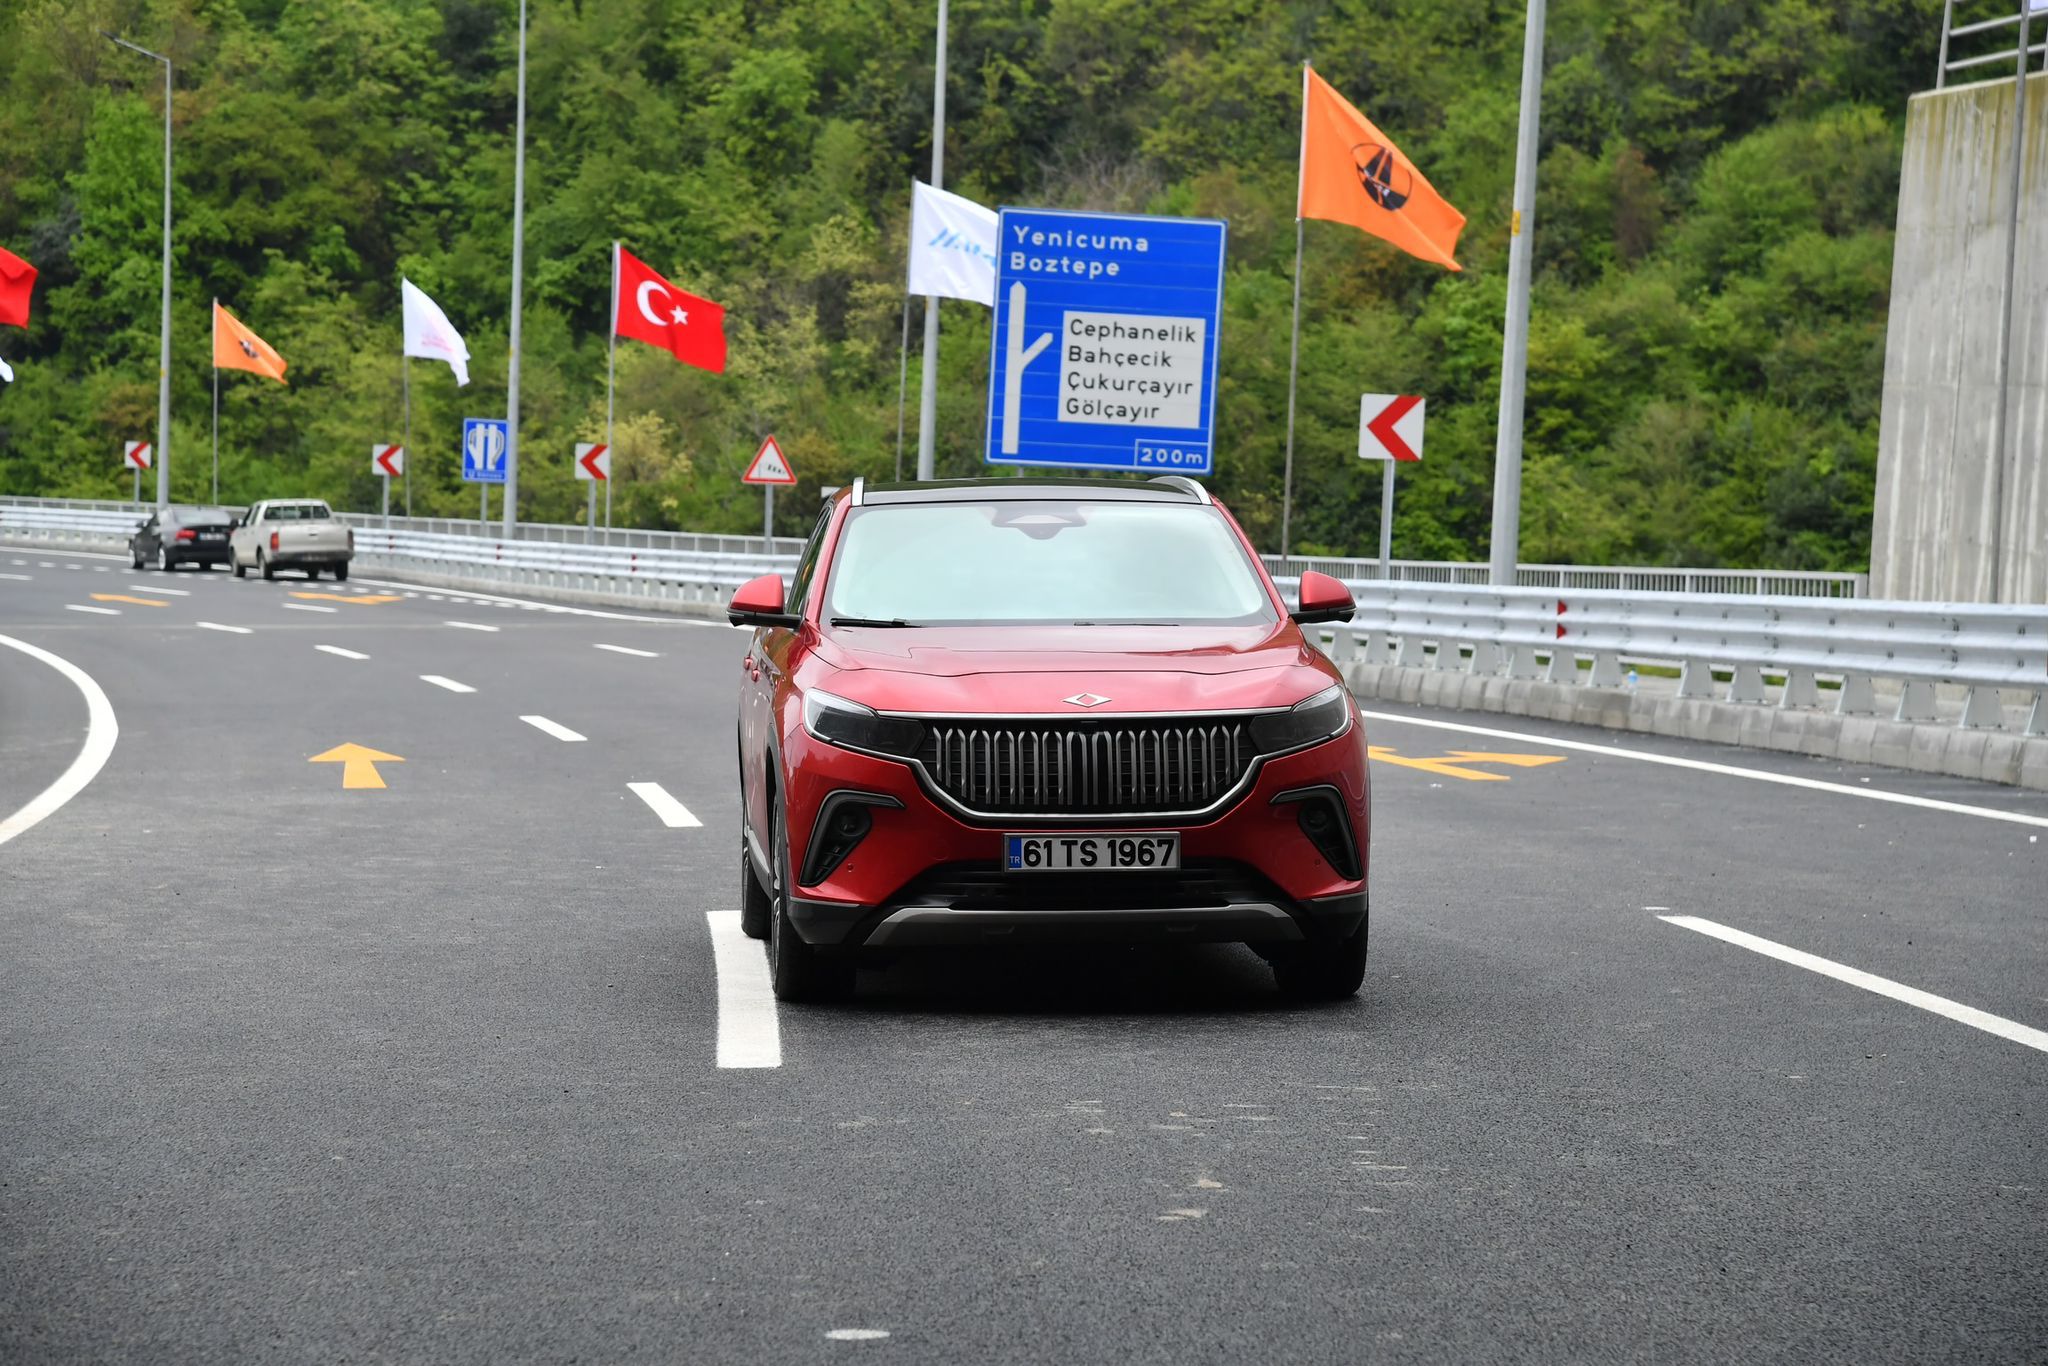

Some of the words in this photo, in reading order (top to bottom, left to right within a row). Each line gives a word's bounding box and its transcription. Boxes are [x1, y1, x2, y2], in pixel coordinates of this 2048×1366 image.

[1013, 225, 1149, 252] Yenicuma
[1010, 252, 1120, 280] Boztepe
[1069, 318, 1196, 343] Cephanelik
[1068, 345, 1172, 368] Bahçecik
[1067, 371, 1193, 398] Çukurçayır
[1066, 398, 1160, 423] Gölçayır
[1140, 447, 1203, 464] 200m
[1009, 855, 1021, 864] TR
[1023, 839, 1053, 867] 61
[1060, 839, 1098, 867] TS
[1107, 839, 1175, 867] 1967
